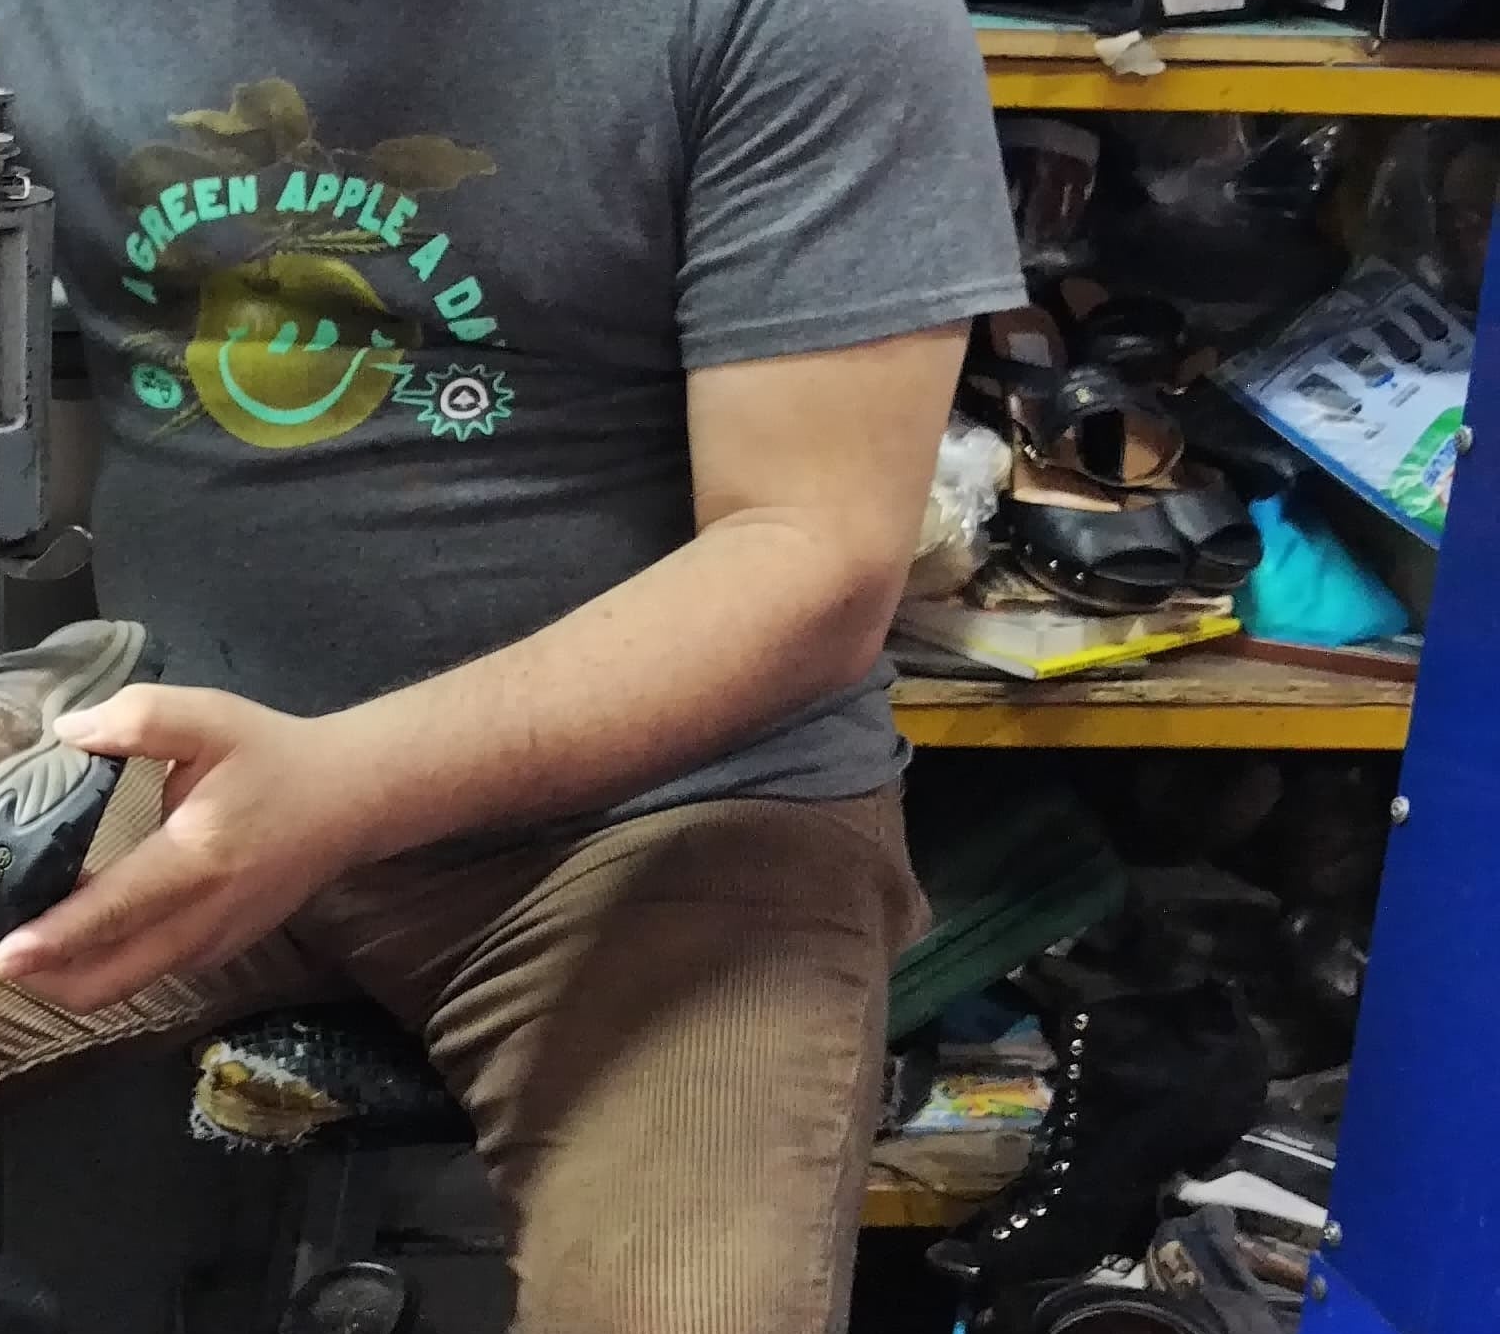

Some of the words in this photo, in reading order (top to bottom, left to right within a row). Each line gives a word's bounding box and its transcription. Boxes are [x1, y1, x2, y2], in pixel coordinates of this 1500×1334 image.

[126, 176, 258, 272] GREEN
[276, 171, 418, 247] APPLE
[408, 233, 450, 282] A
[434, 276, 500, 343] DA
